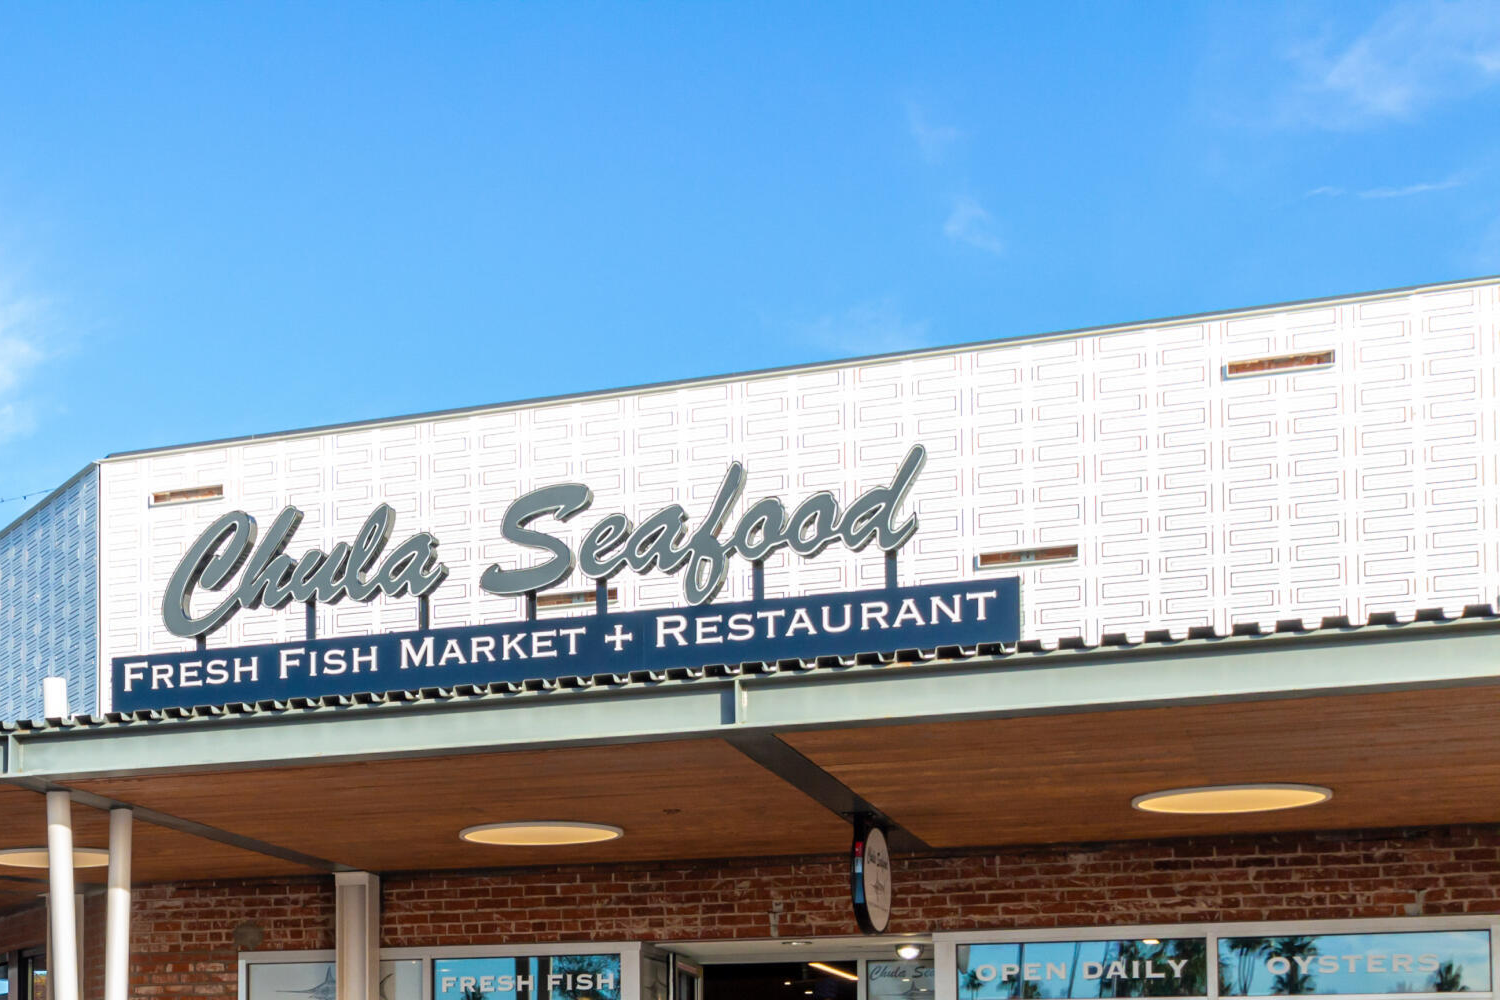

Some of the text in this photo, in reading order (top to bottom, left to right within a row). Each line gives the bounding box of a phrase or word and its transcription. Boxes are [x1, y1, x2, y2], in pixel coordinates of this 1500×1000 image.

[162, 443, 927, 638] Chula Seafood
[123, 656, 259, 693] FRESH
[279, 646, 379, 680] FISH
[400, 626, 587, 670] MARKET
[656, 590, 998, 649] RESTAURANT
[975, 958, 1189, 982] OPEN DAILY
[1266, 953, 1440, 975] OYSTERS
[441, 973, 615, 994] FRESH FISH
